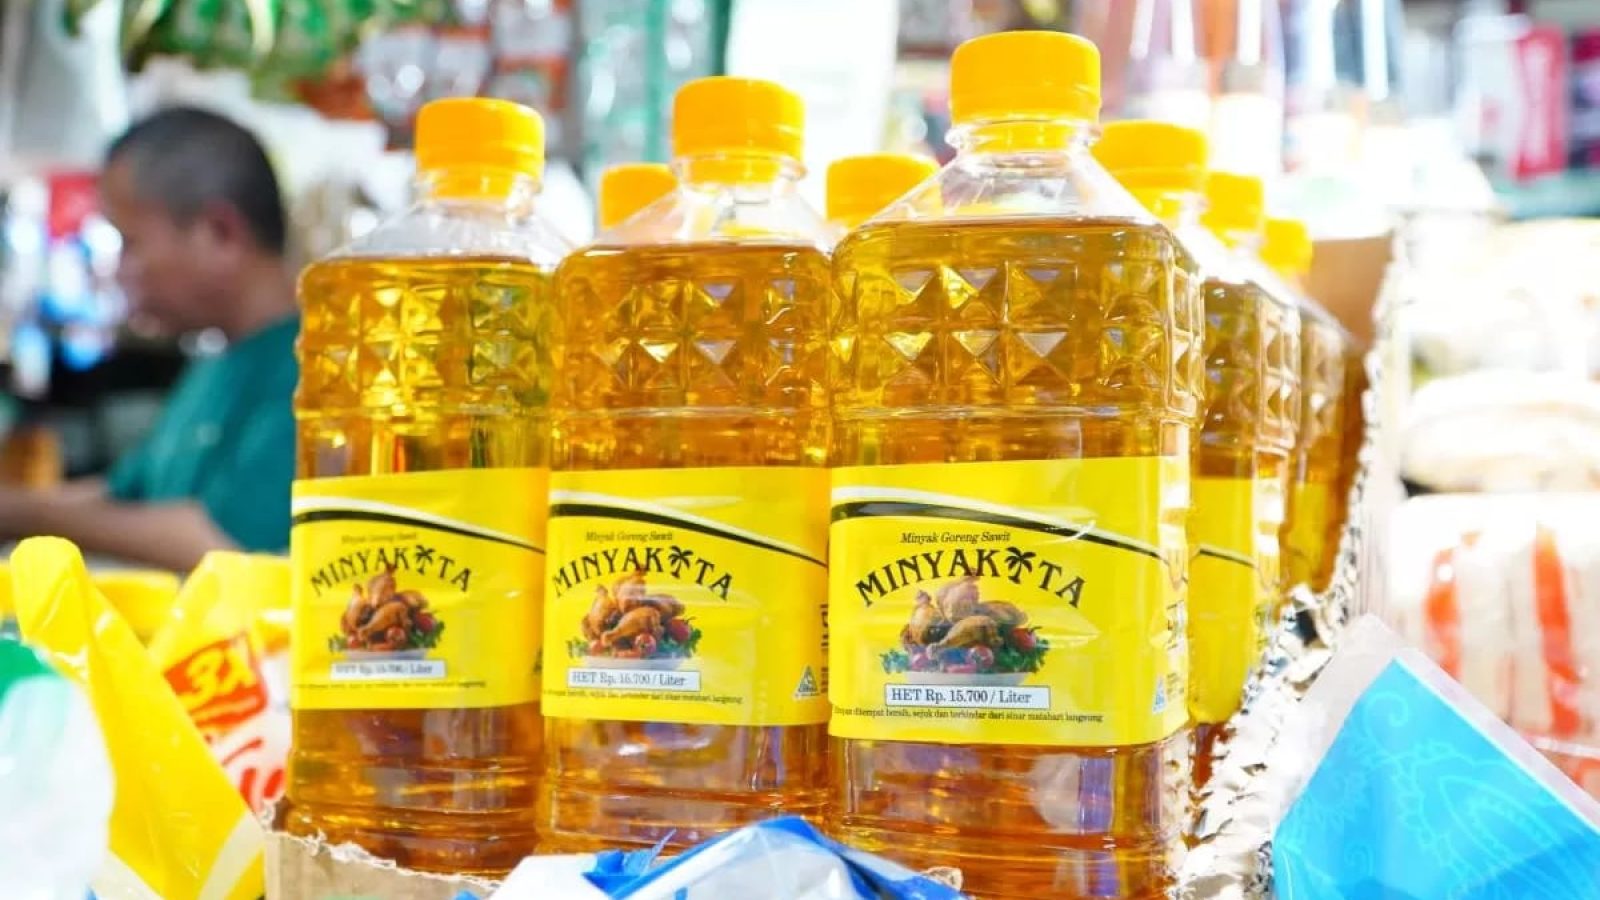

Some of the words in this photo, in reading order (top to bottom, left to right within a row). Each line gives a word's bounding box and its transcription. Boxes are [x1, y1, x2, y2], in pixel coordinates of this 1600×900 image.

[899, 531, 939, 544] Minyak
[941, 531, 979, 544] Goreng
[981, 531, 1011, 542] Sawit
[572, 671, 597, 683] HET
[659, 674, 686, 686] Liter
[891, 687, 922, 701] HET
[925, 688, 946, 705] Rp.
[949, 689, 989, 703] 15.700
[999, 689, 1032, 704] Liter
[934, 708, 949, 718] dan
[987, 710, 1005, 720] dari
[1006, 711, 1026, 720] sinar
[1066, 711, 1104, 722] langsung
